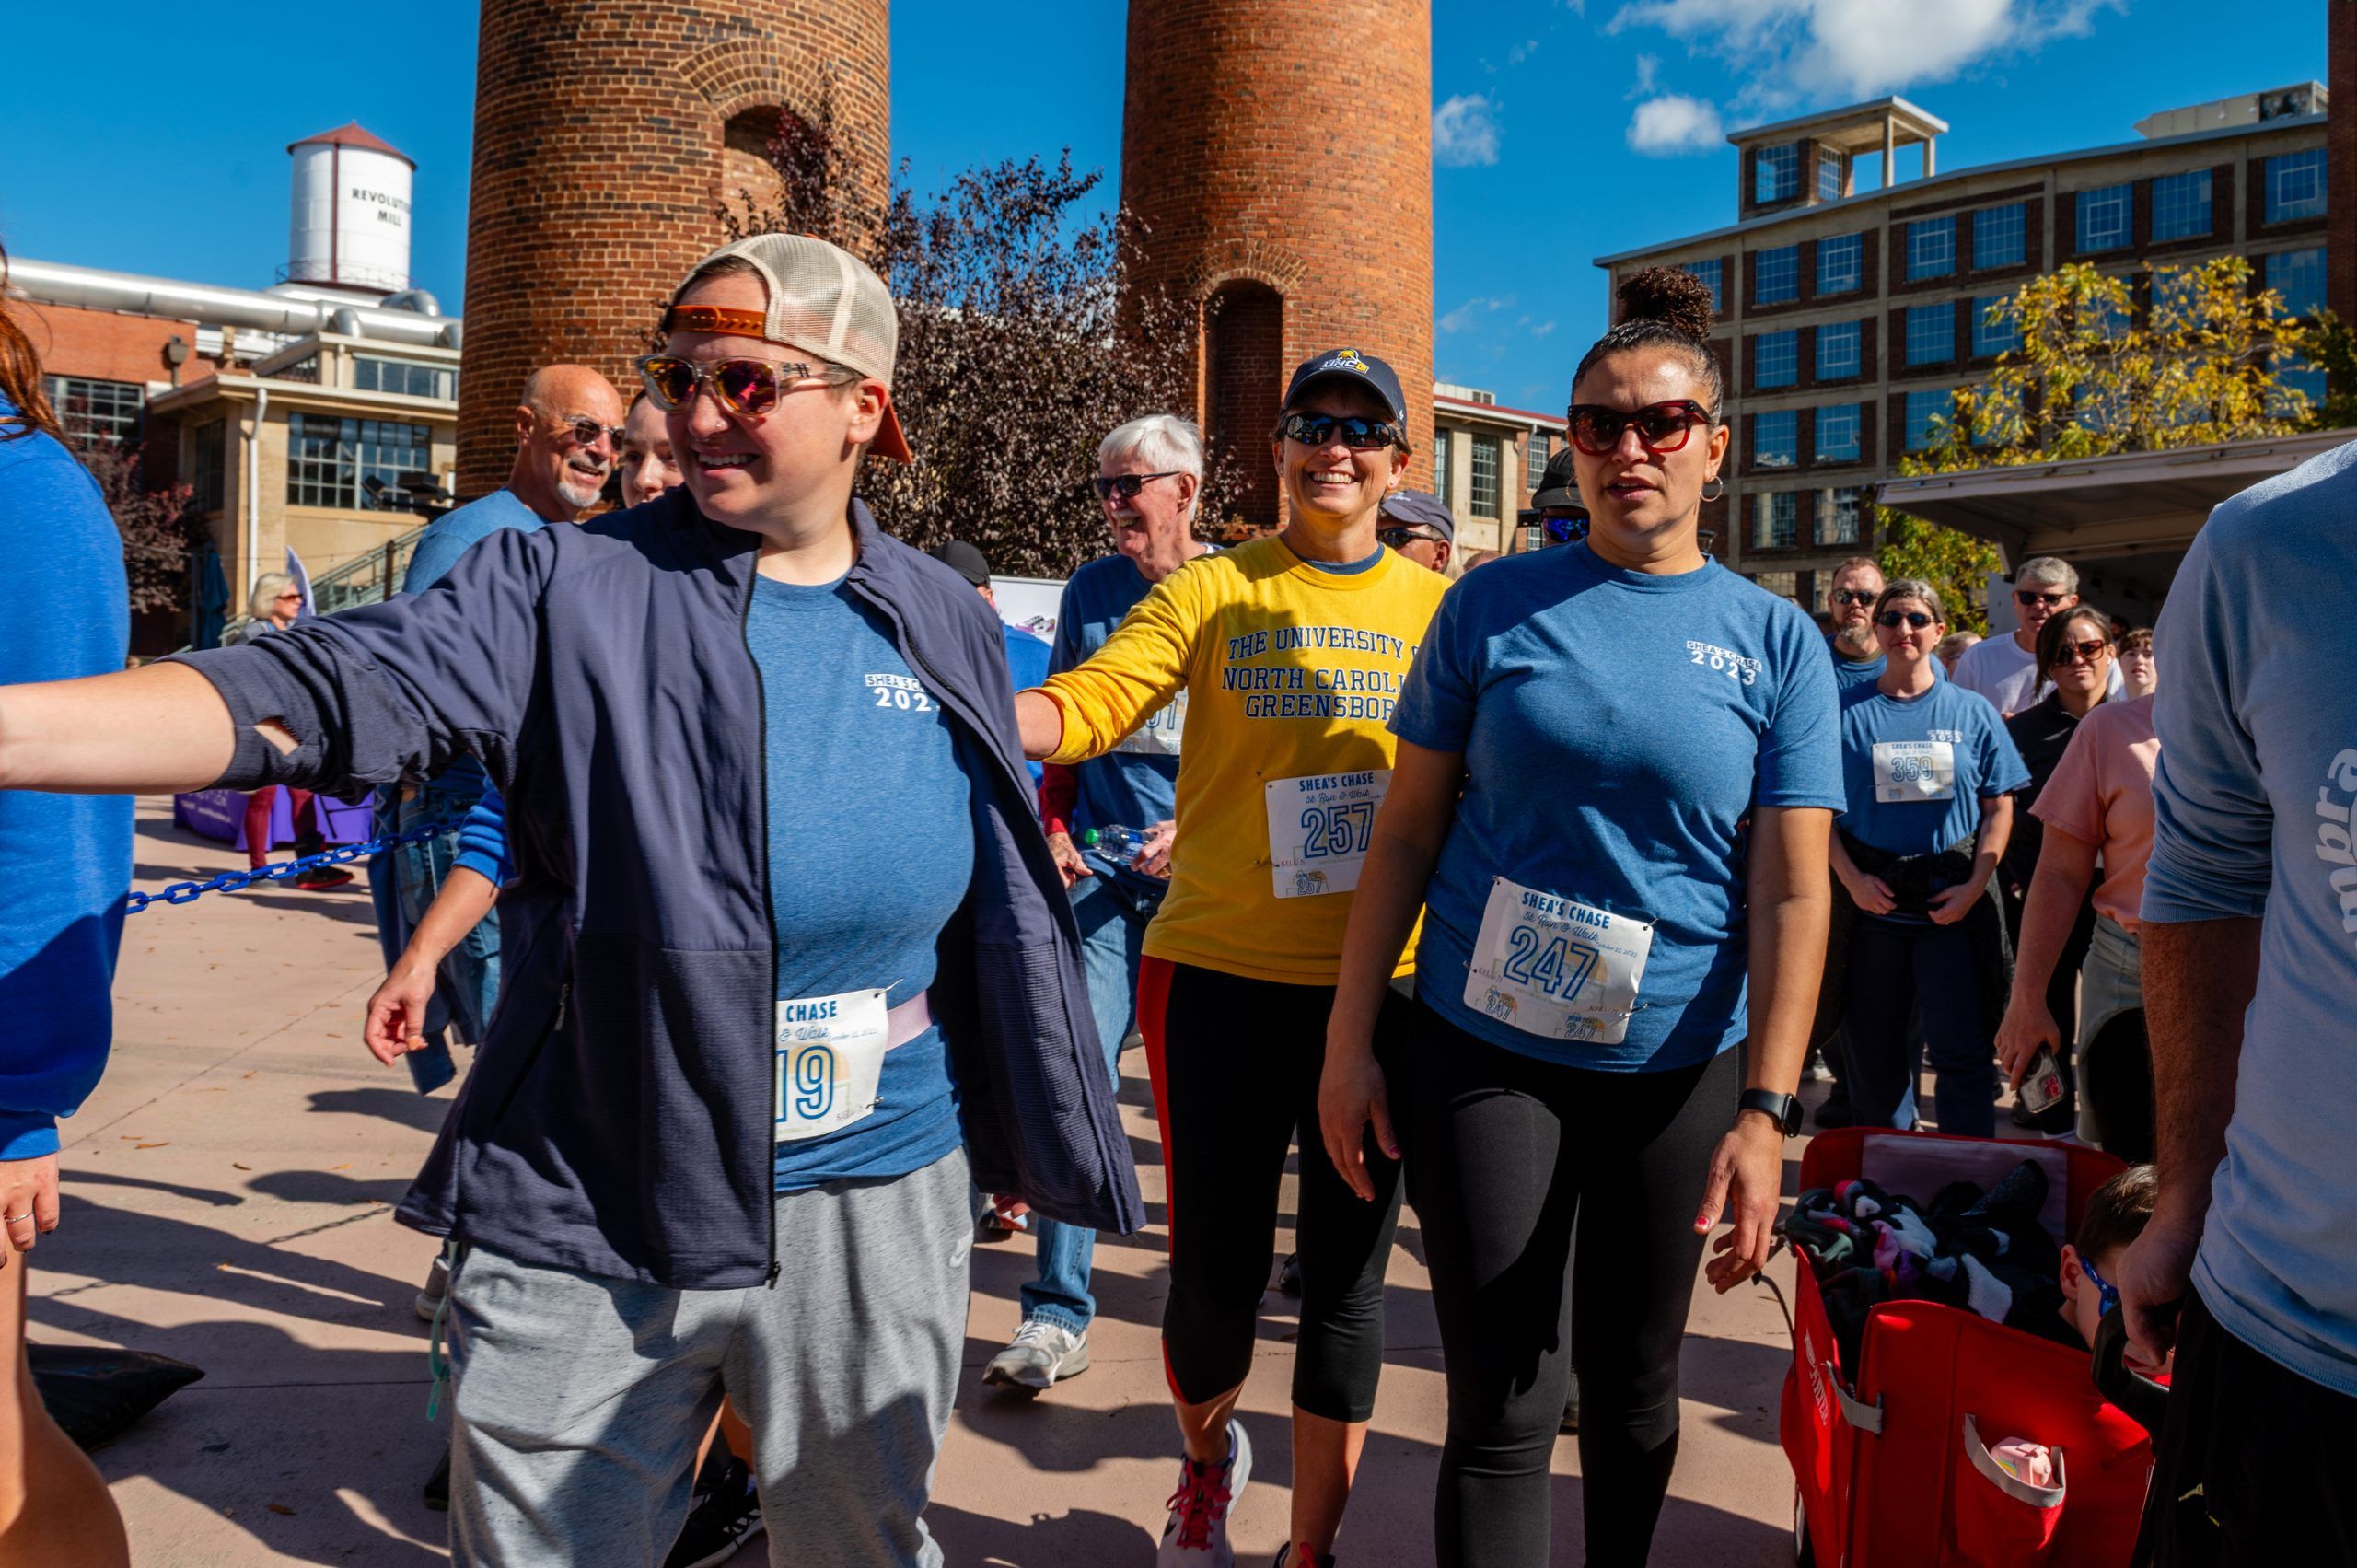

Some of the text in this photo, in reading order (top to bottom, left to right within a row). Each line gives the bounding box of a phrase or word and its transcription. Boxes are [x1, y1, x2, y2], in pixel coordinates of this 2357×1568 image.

[377, 210, 401, 227] MILL
[1228, 631, 1268, 660] THE
[1274, 626, 1403, 659] UNIVERSITY
[1222, 666, 1305, 691] NORTH
[1690, 650, 1757, 686] 2023
[873, 686, 940, 712] 202
[1299, 772, 1374, 792] SHEA'S CHASE
[1891, 756, 1933, 782] 359
[1318, 792, 1337, 804] Run
[1301, 801, 1373, 858] 257
[1296, 877, 1323, 896] 257
[1522, 891, 1610, 930] SHEA'S CHASE
[1538, 914, 1558, 929] Run
[1573, 925, 1599, 942] Walk
[1504, 925, 1600, 1002] 247
[785, 1000, 838, 1023] CHASE
[1485, 994, 1514, 1021] 247
[795, 1027, 829, 1041] Walk
[1564, 1022, 1598, 1040] 247
